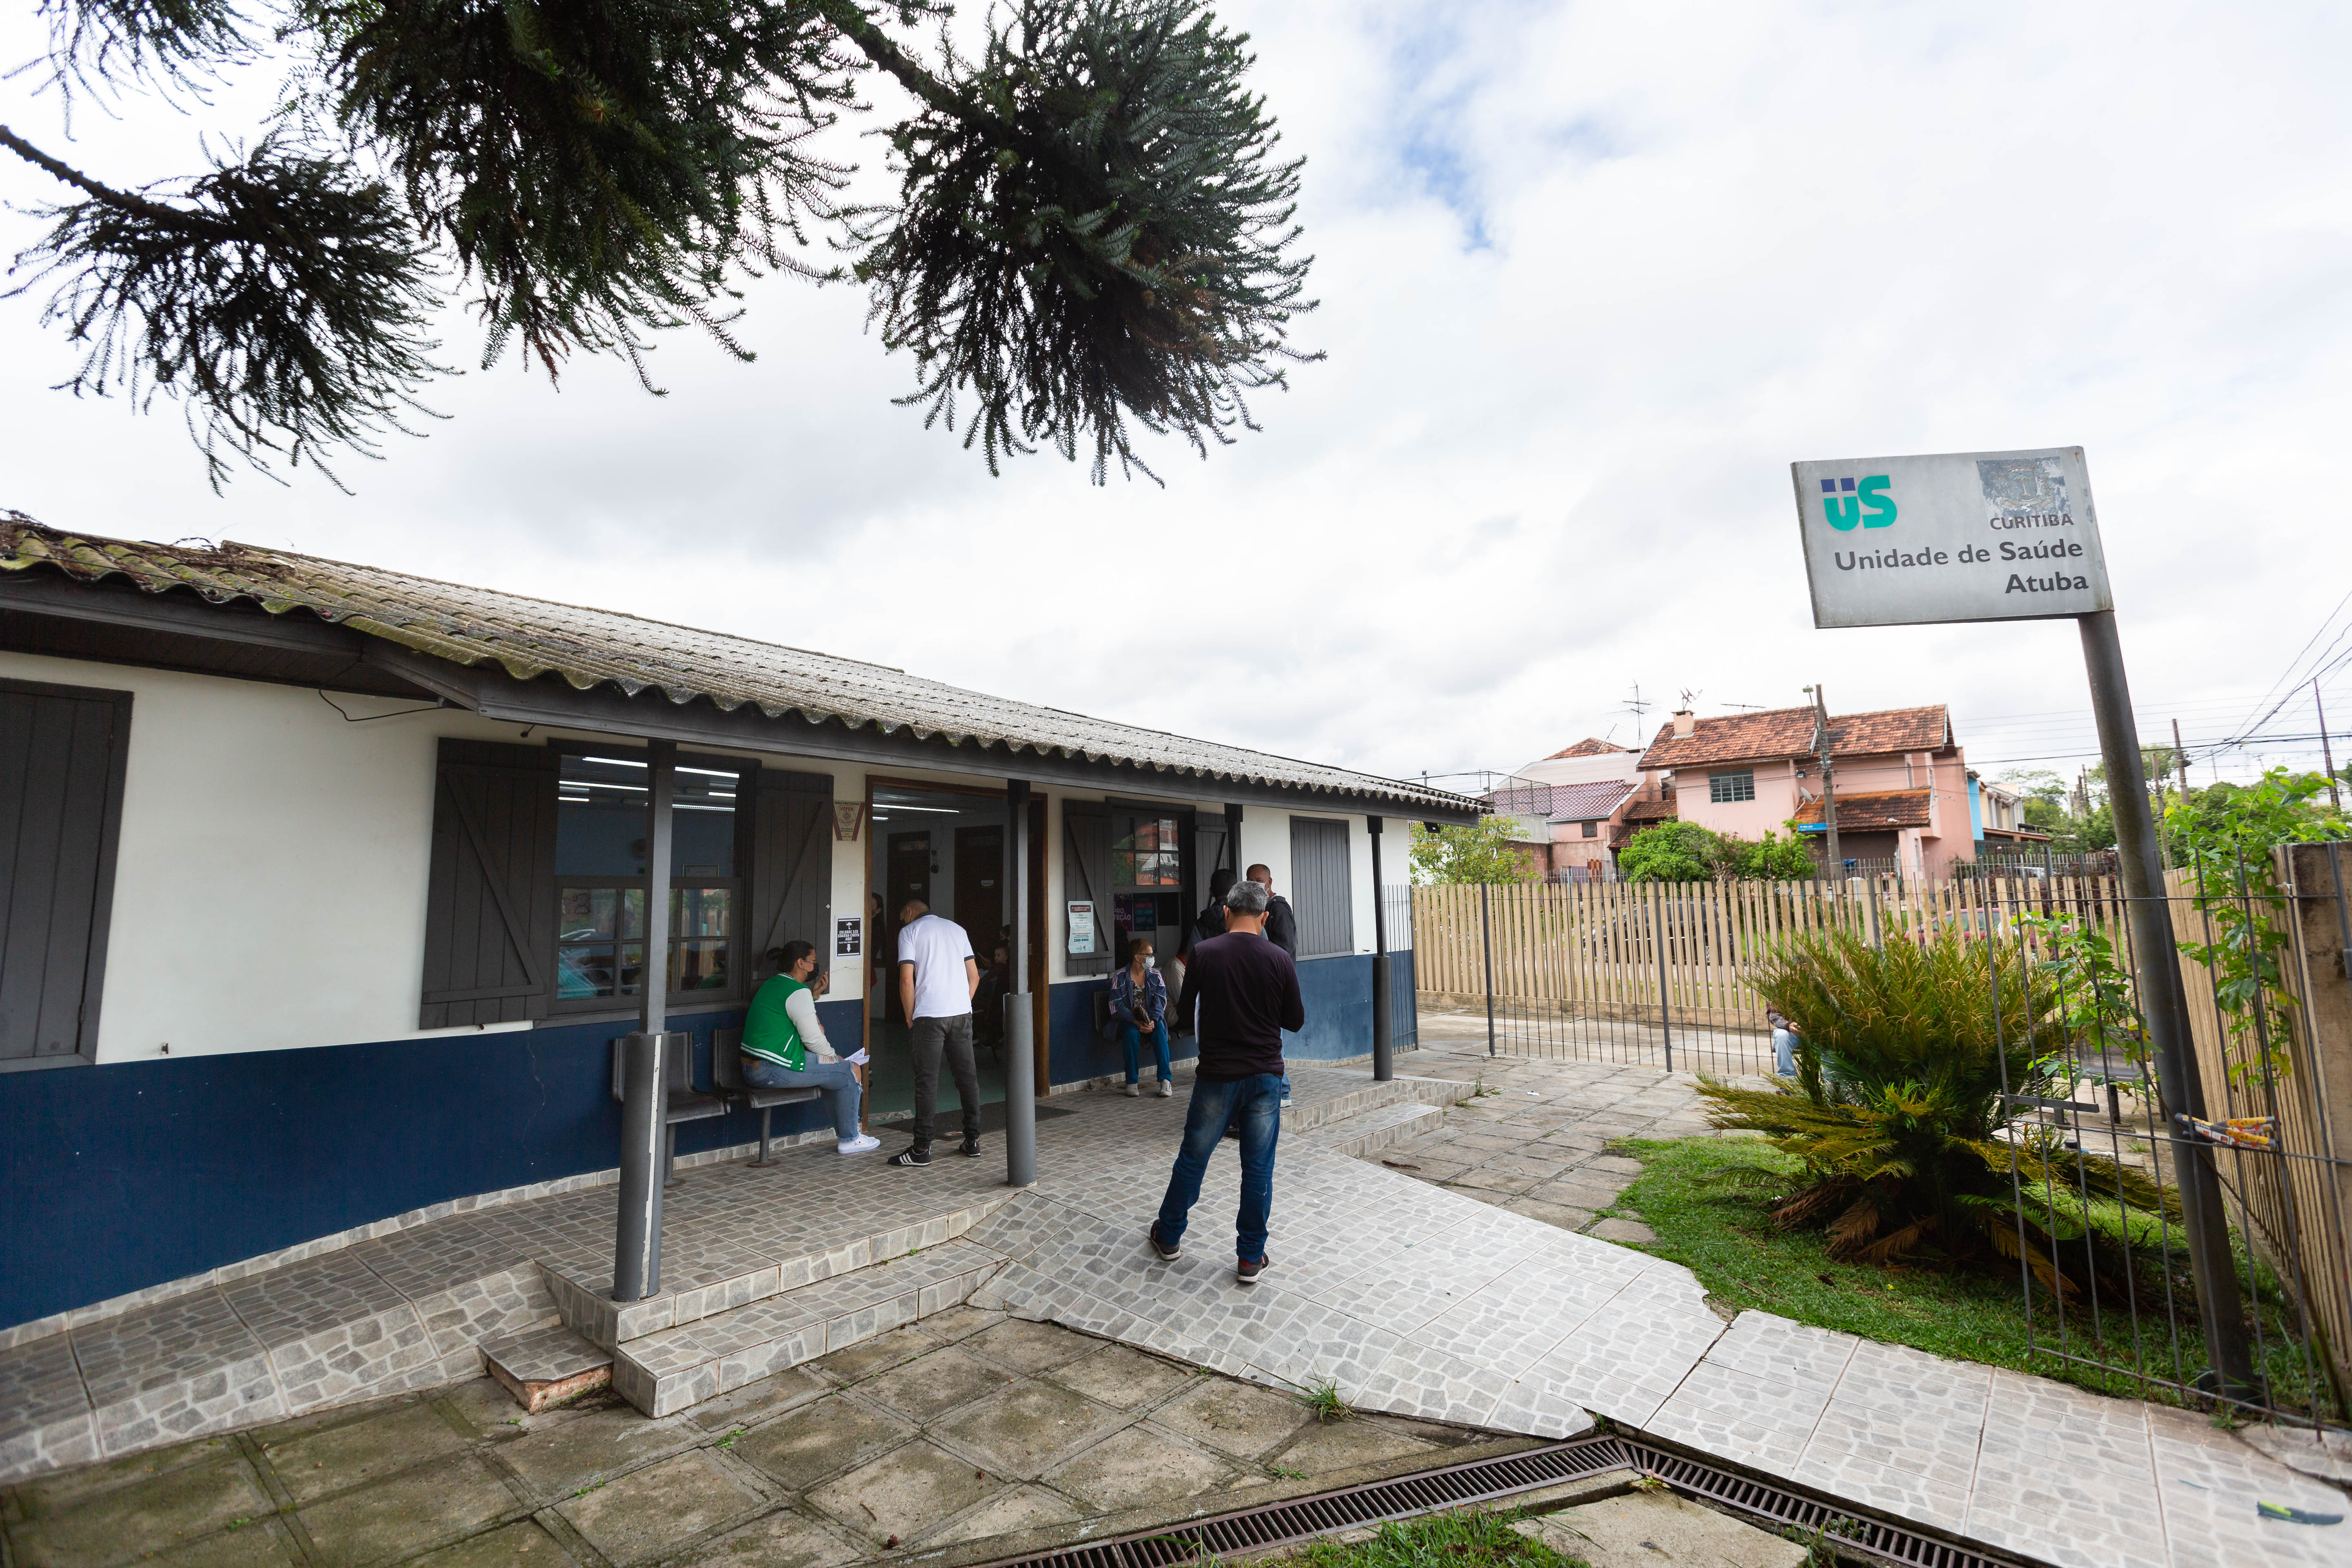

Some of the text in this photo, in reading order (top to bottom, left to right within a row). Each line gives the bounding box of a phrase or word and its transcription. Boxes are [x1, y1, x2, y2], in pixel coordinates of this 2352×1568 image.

[1990, 513, 2074, 530] CURITIBA
[1834, 538, 2083, 571] Unidade de Saúde
[2005, 572, 2089, 594] Atuba
